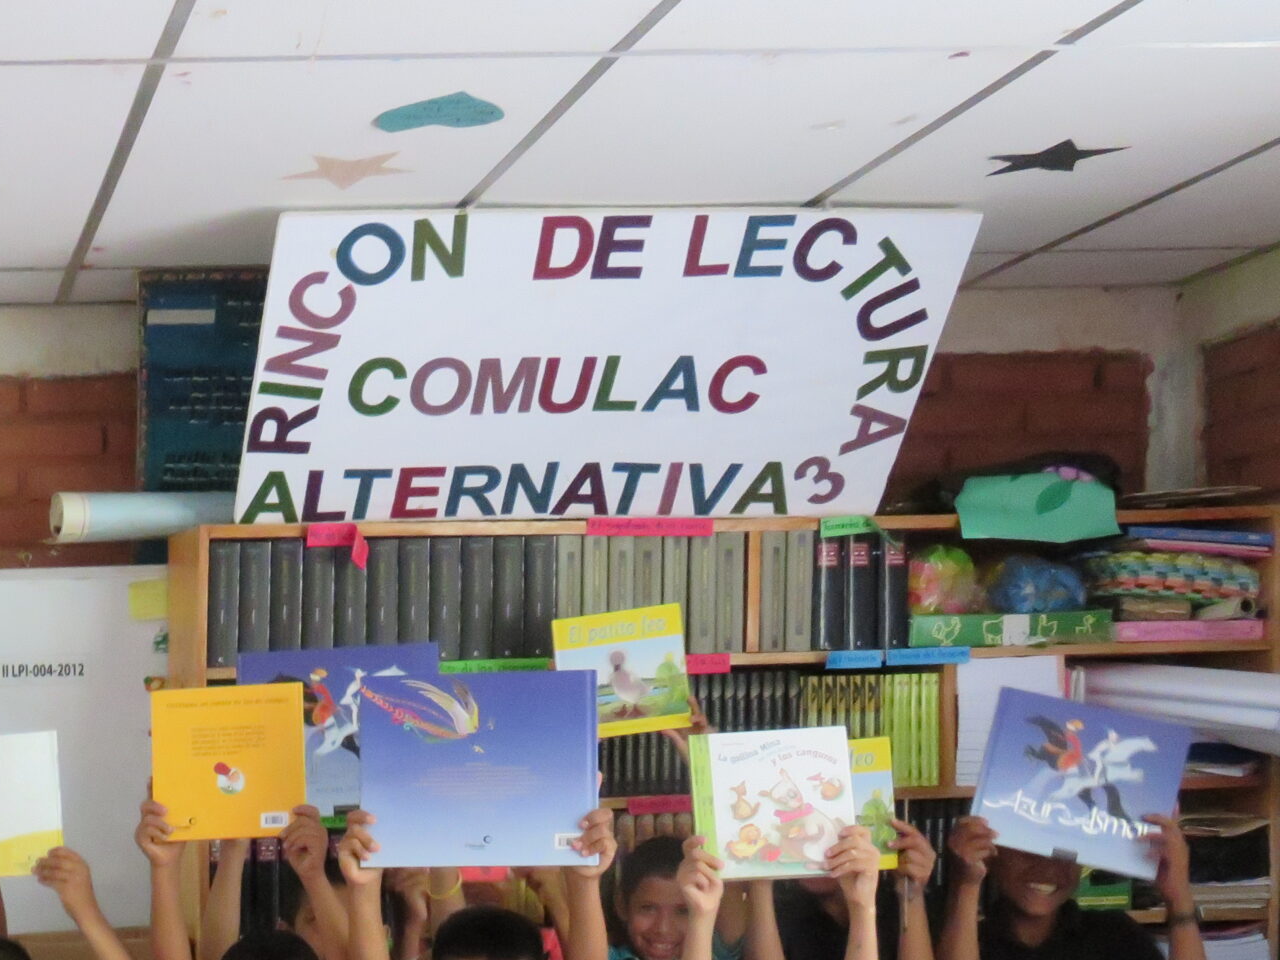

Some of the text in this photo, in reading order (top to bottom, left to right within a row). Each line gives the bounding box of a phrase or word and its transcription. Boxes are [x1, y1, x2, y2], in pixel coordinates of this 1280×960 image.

[246, 214, 929, 457] RINCON DE LECTURA
[348, 355, 768, 416] COMULAC
[239, 461, 787, 524] ALTERNATIVA
[12, 663, 85, 678] LPI-004-2012
